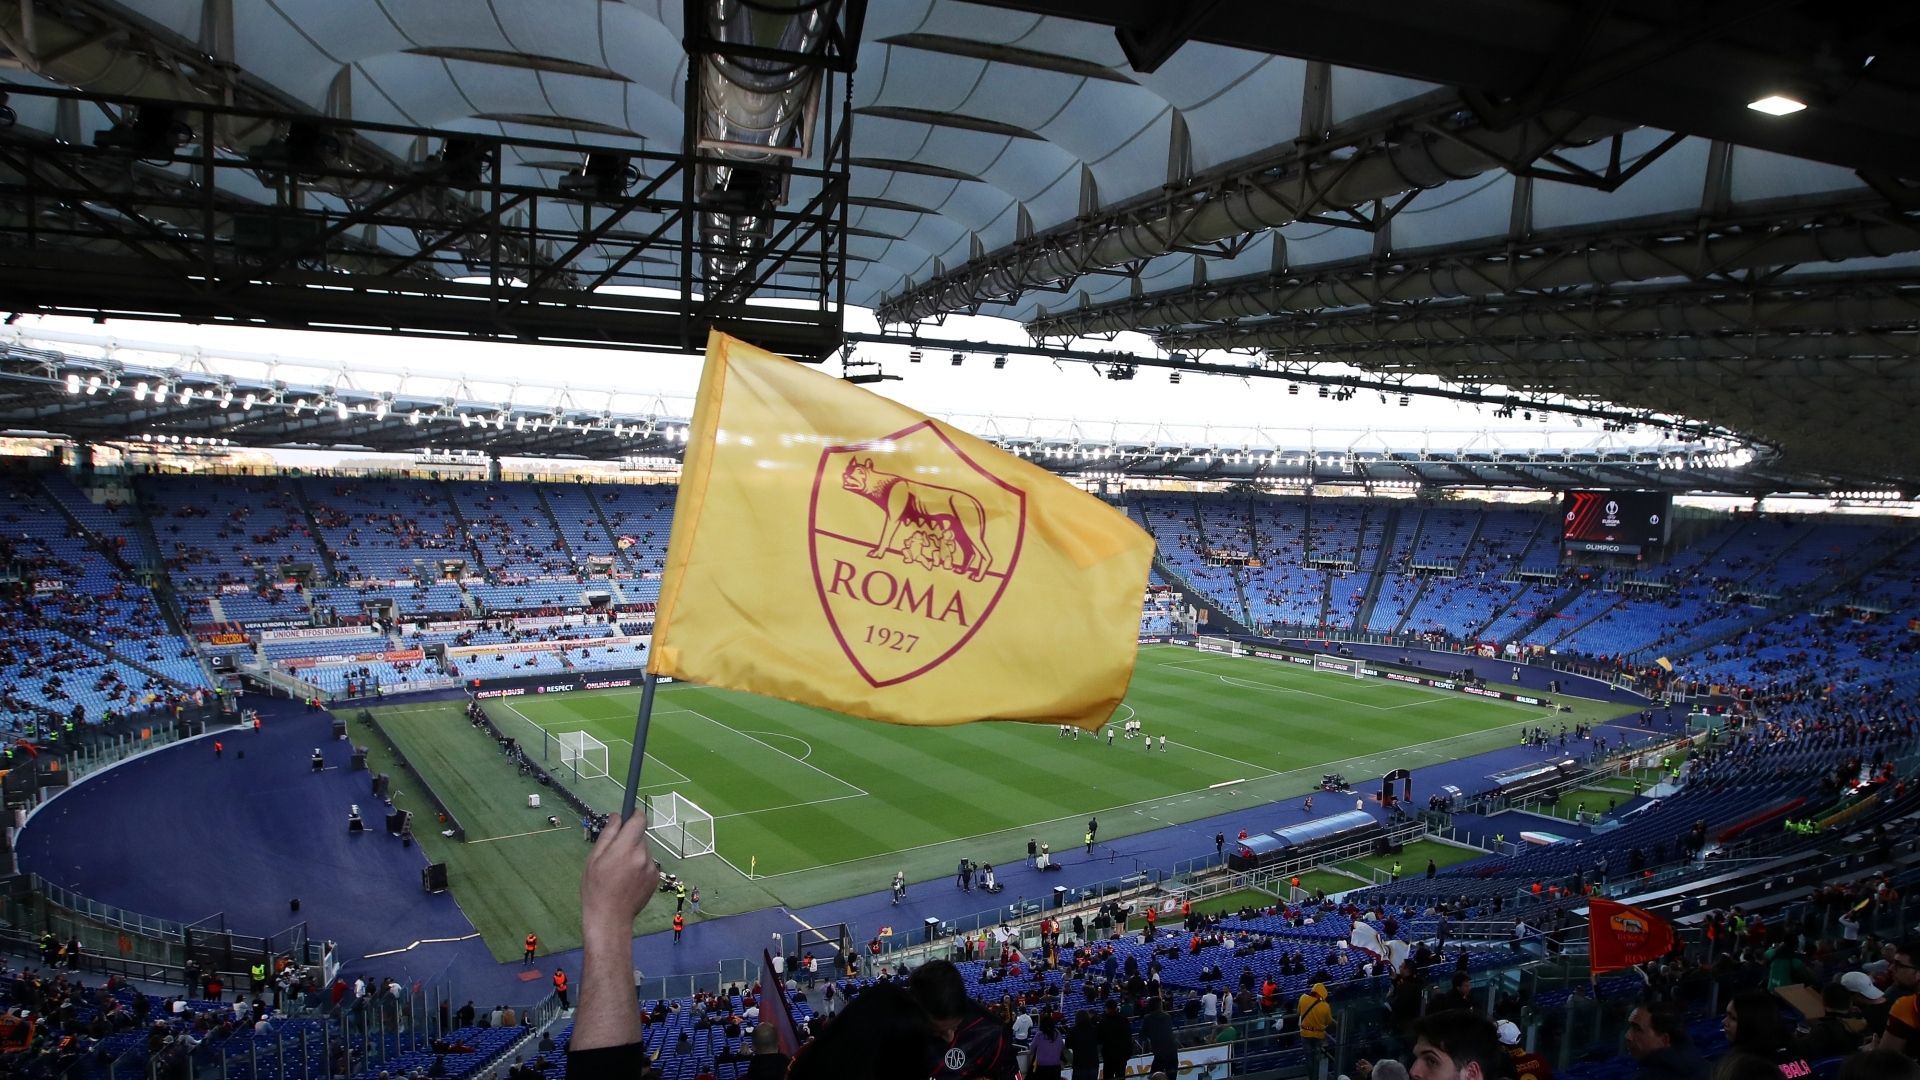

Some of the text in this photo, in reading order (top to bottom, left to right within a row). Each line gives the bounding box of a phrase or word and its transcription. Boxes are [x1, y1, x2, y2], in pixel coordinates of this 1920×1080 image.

[1586, 544, 1620, 552] OLIMPICO
[827, 559, 970, 627] ROMA
[273, 626, 362, 639] UNIONE TIFOSI ROMANISTI
[864, 625, 919, 653] 1927
[212, 657, 221, 665] C
[1294, 657, 1311, 665] RESPECT
[1404, 676, 1420, 684] ABUSE
[547, 685, 573, 693] RESPECT
[587, 682, 610, 690] ONLINE
[1435, 681, 1455, 690] RESPECT
[478, 688, 525, 699] ONLINE ABUSE
[1464, 686, 1501, 698] ONLINE ABUSE
